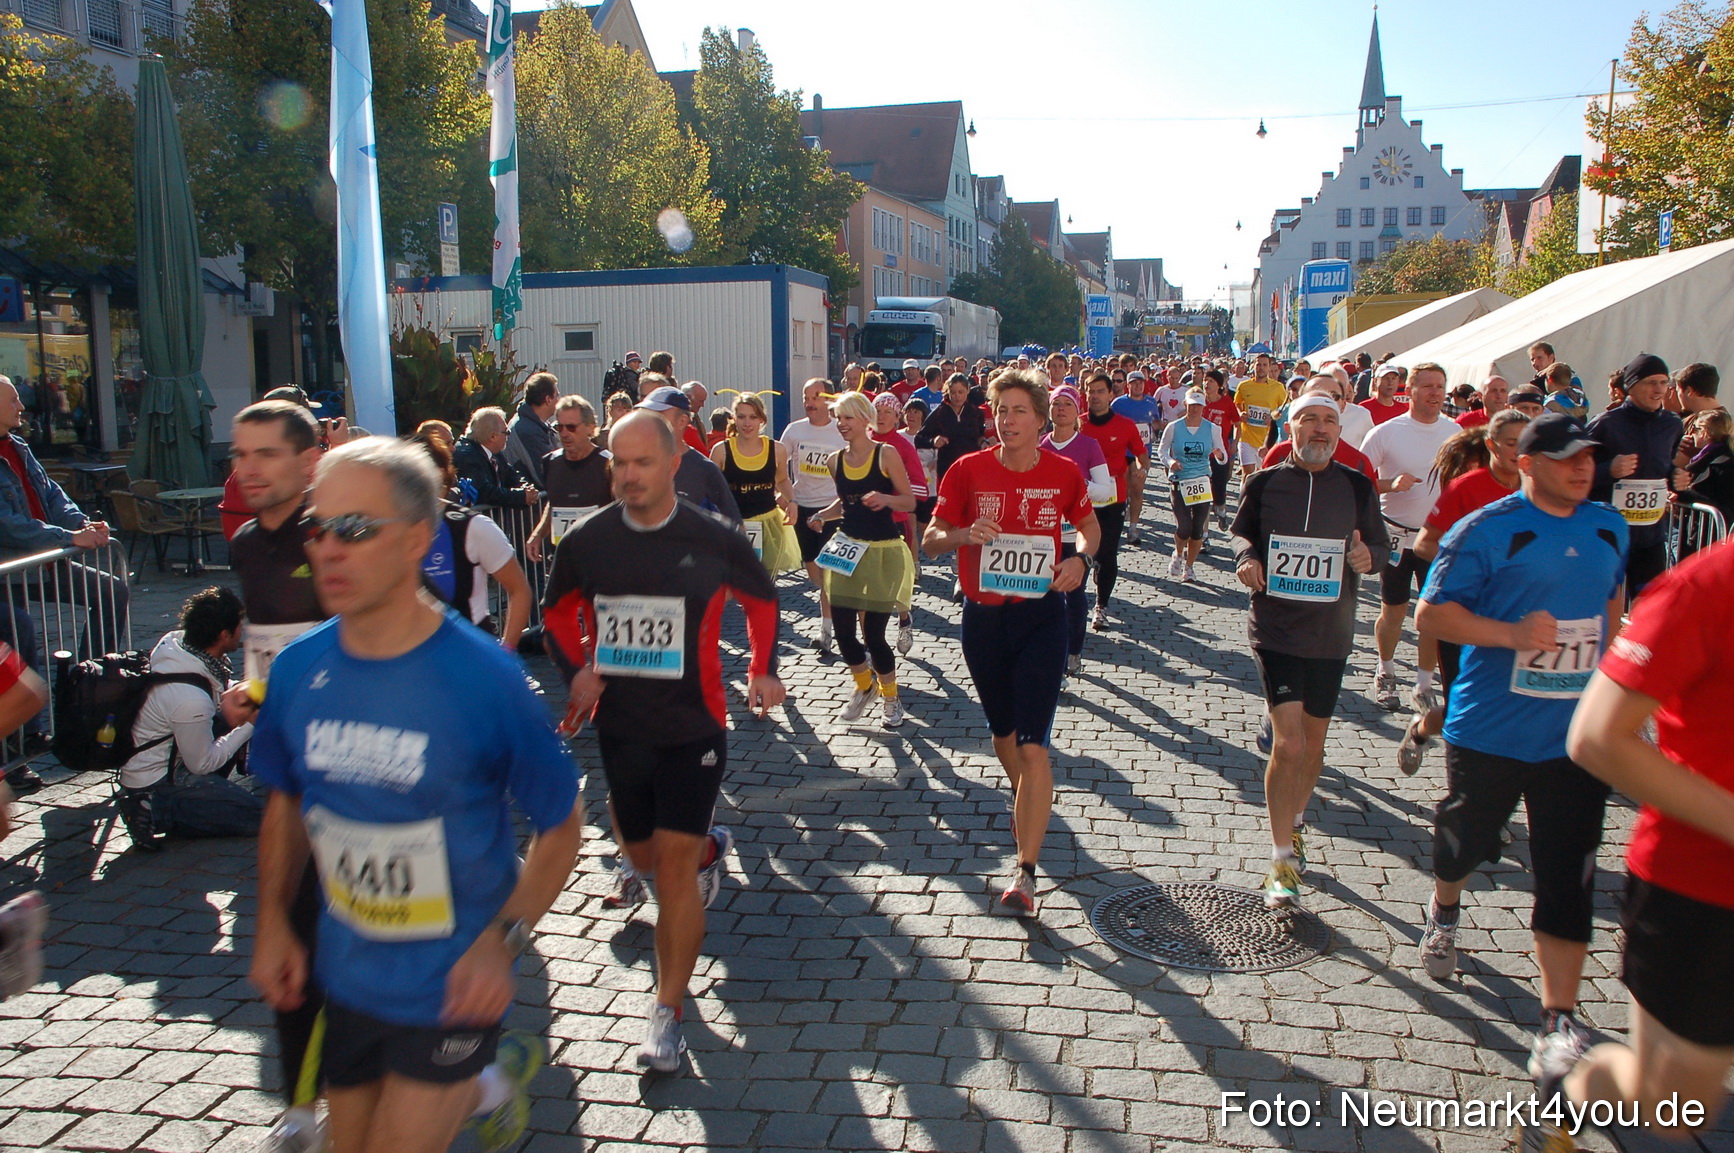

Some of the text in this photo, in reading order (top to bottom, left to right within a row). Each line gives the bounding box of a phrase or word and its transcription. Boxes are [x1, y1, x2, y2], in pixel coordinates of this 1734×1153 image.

[442, 208, 453, 237] P
[1662, 216, 1670, 243] P
[1310, 267, 1346, 288] maxi
[1095, 318, 1105, 326] dsl
[806, 451, 829, 466] 473
[1186, 483, 1205, 496] 286
[1625, 491, 1658, 508] 838
[1280, 541, 1313, 550] PFLEIDERER
[989, 549, 1047, 575] 2007
[1276, 552, 1333, 579] 2701
[994, 574, 1039, 590] Yvonne
[1278, 578, 1330, 594] Andreas
[605, 615, 673, 648] 3133
[612, 647, 662, 665] Gerald
